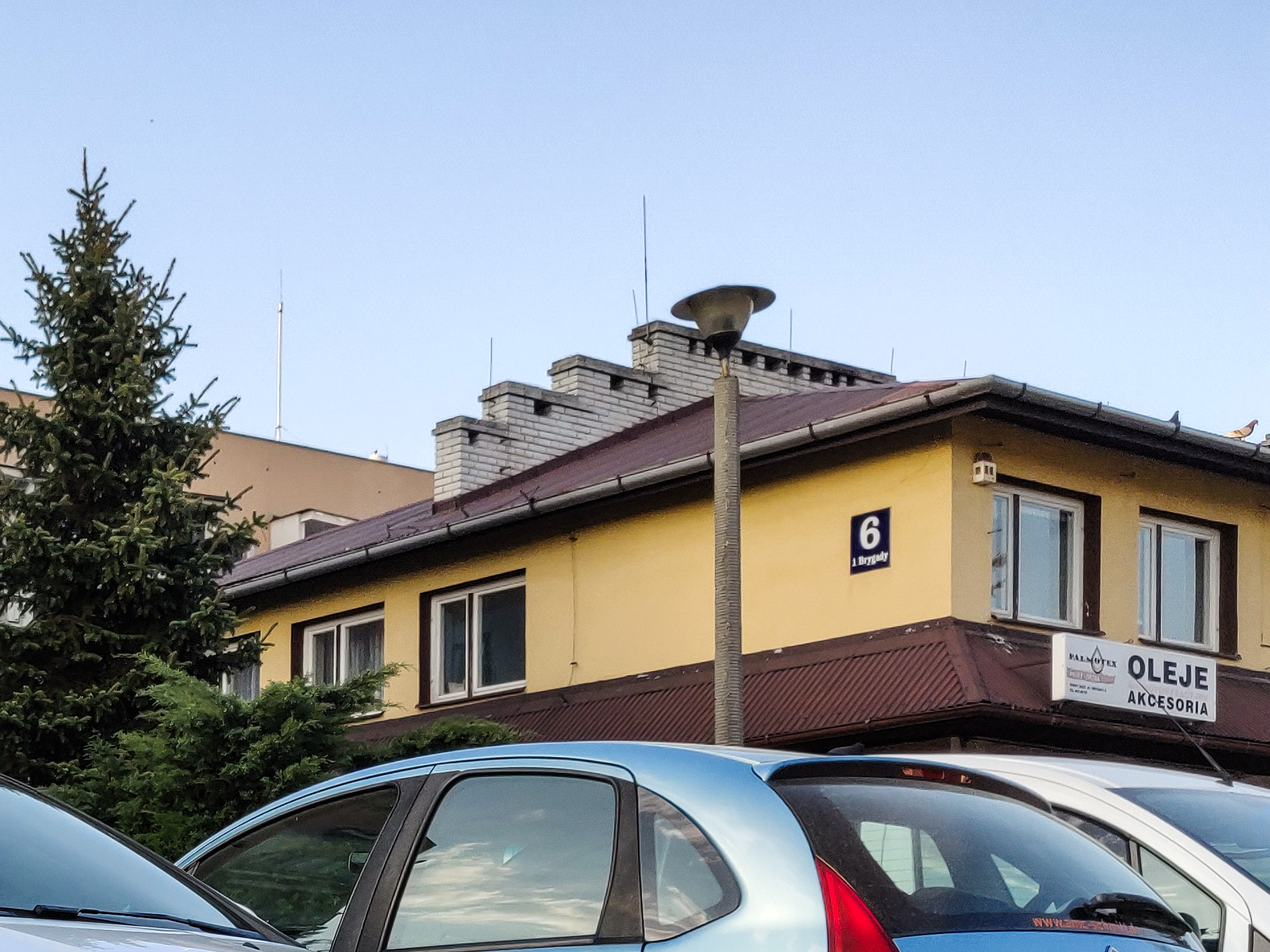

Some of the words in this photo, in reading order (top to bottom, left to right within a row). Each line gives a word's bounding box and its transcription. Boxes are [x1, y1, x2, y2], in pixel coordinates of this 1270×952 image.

[859, 515, 881, 550] 6
[858, 550, 889, 567] Brygady
[1128, 654, 1209, 691] OLEJE
[1127, 690, 1209, 716] AKCESORIA
